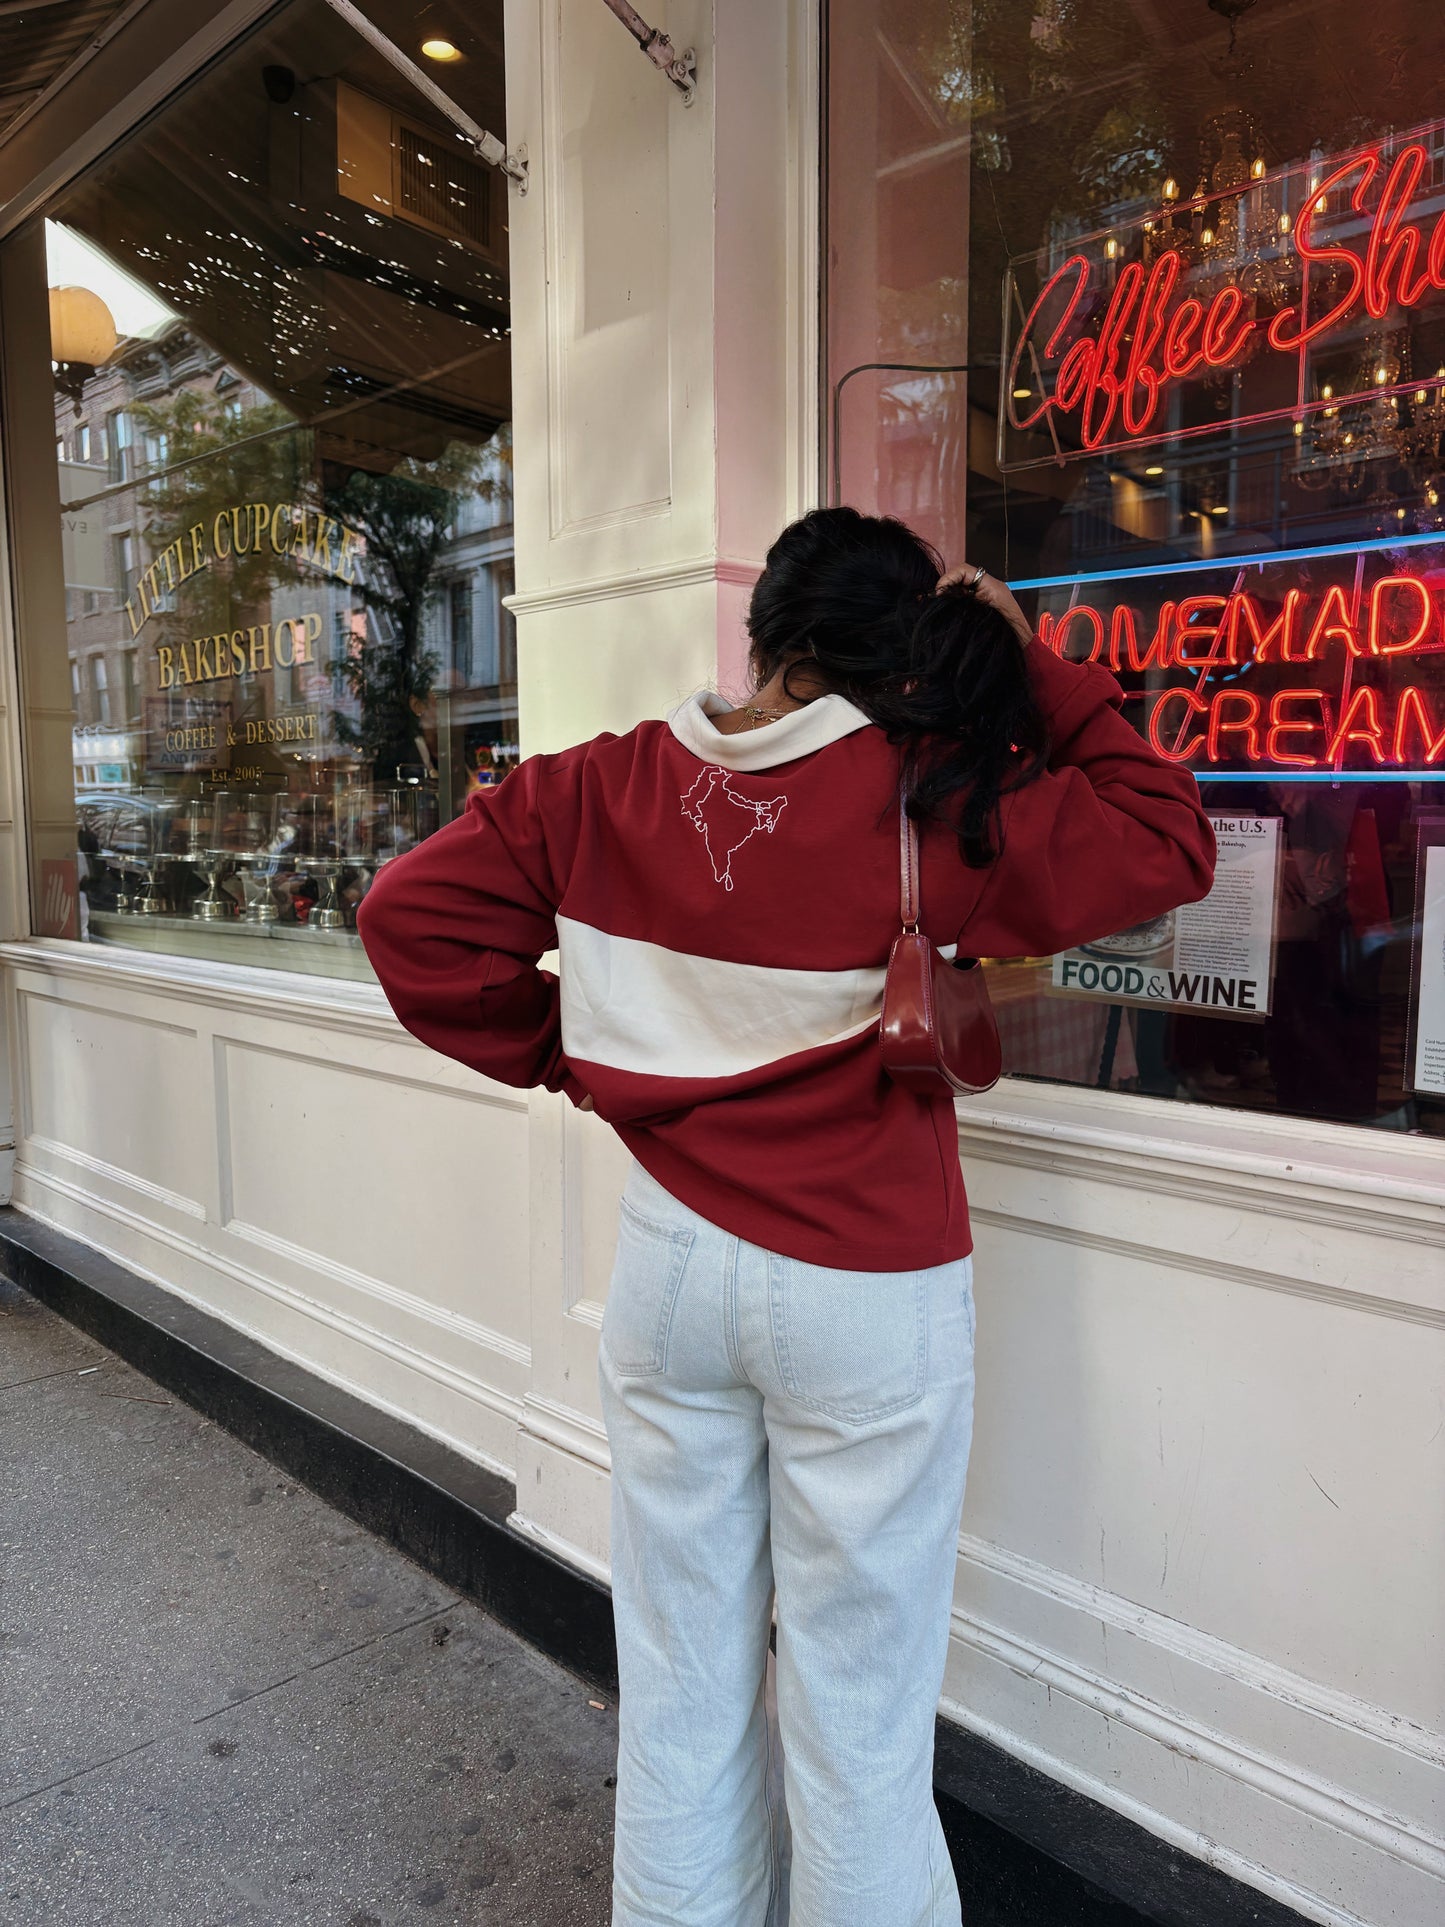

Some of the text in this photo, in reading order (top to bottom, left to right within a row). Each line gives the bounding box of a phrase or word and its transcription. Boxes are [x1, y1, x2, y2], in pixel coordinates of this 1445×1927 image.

[1009, 250, 1256, 450] Coffee
[124, 502, 357, 639] LITTLE CUPCAKE
[157, 612, 323, 690] BAKESHOP
[1038, 574, 1445, 672] OMEMAD
[165, 726, 218, 752] COFFEE
[226, 724, 237, 747] &
[246, 714, 317, 745] DESSERT
[211, 766, 263, 783] Est. 2005
[1213, 818, 1268, 834] the U.S.
[44, 872, 72, 936] illy
